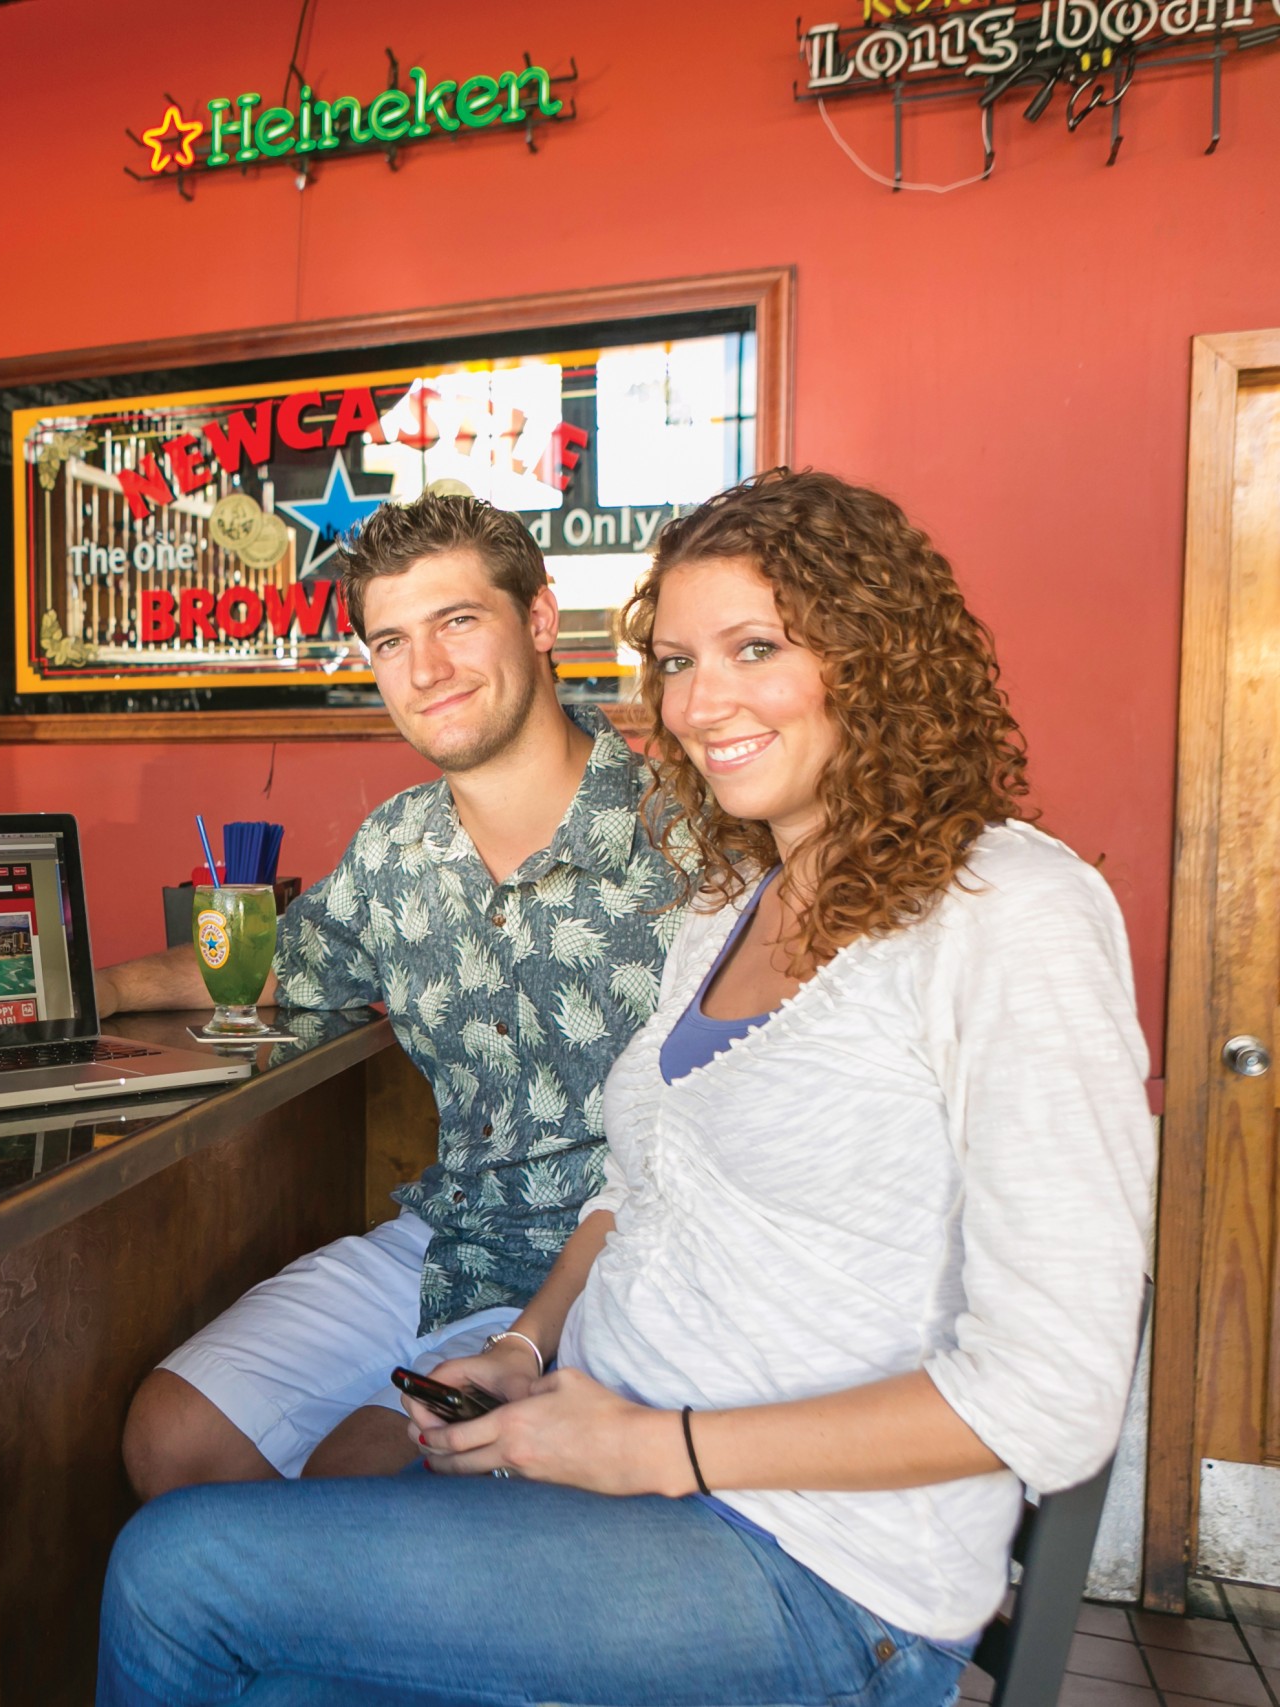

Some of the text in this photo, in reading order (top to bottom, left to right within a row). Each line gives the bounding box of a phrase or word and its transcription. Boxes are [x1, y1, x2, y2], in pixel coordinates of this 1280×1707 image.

[207, 66, 563, 166] Heineken
[70, 539, 126, 576] The
[132, 541, 195, 572] One
[563, 507, 662, 550] Only
